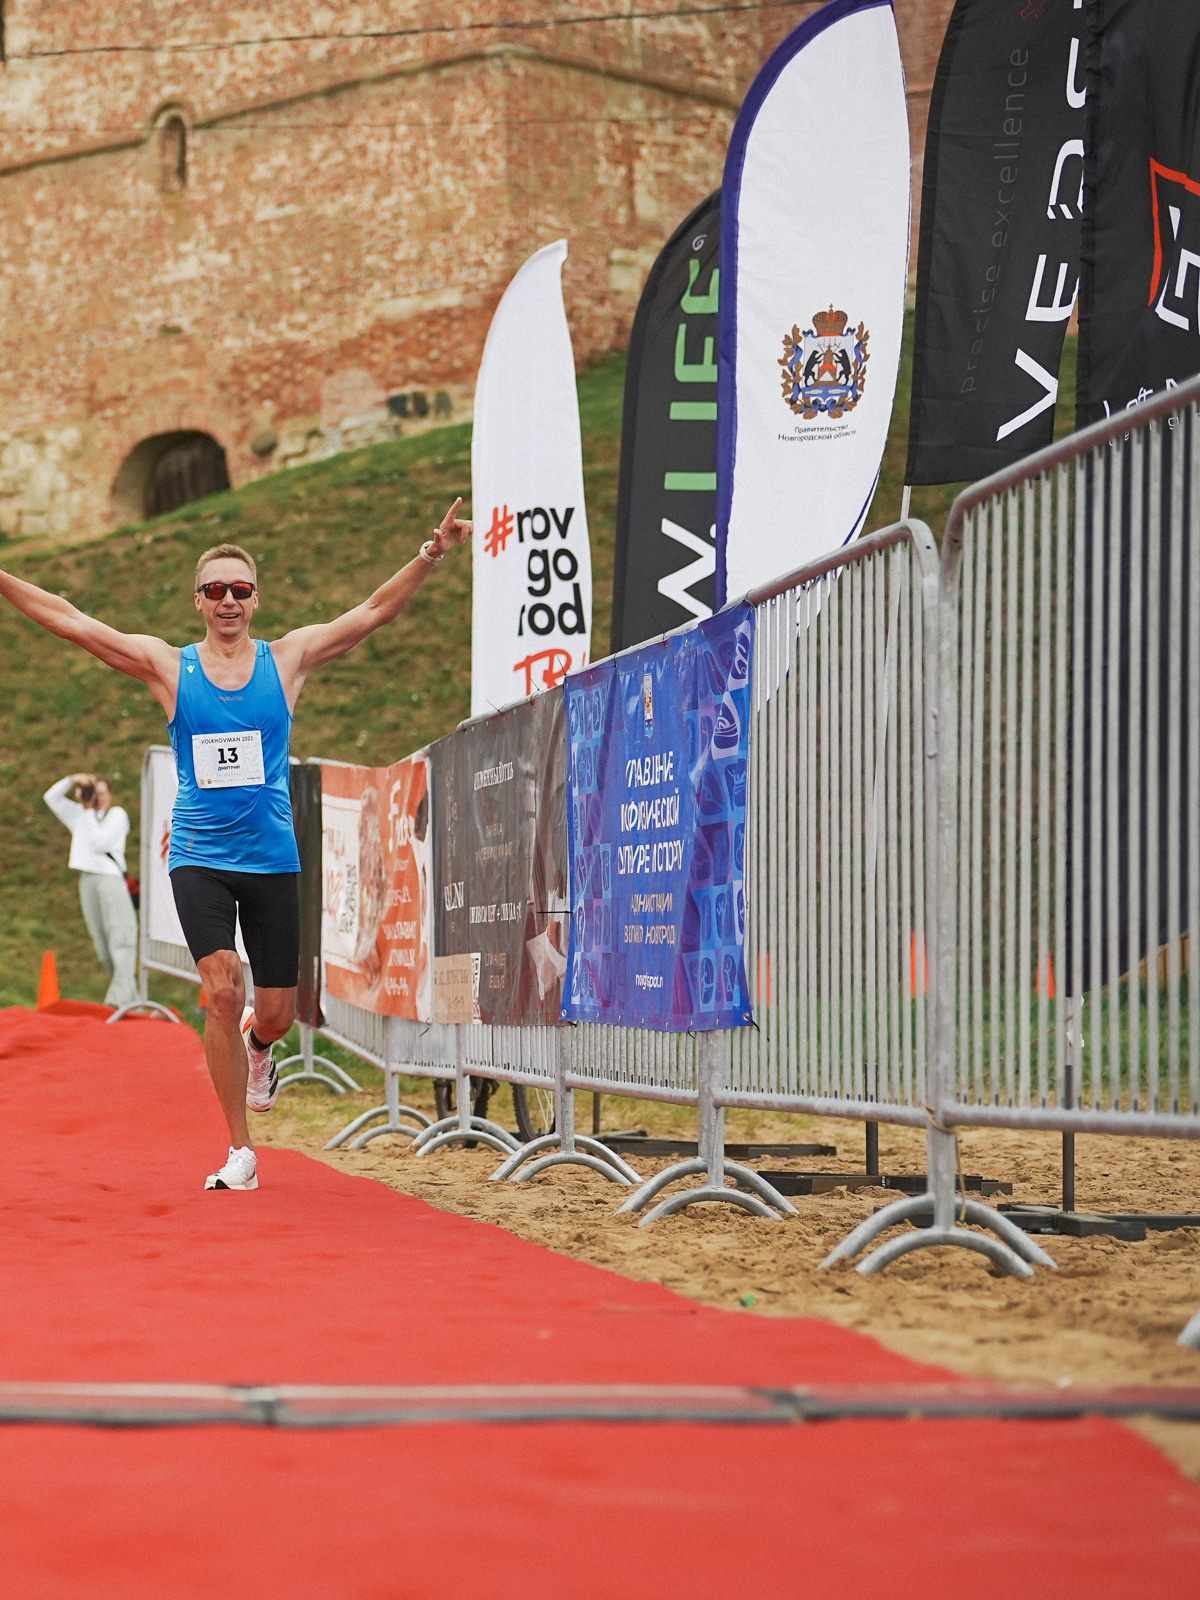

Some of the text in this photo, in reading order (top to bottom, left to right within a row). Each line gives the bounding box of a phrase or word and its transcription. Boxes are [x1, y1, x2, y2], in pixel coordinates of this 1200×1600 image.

[960, 48, 1029, 394] precise excellence
[527, 548, 579, 597] go
[201, 736, 241, 745] VOLKHOVMAN
[217, 747, 239, 764] 13
